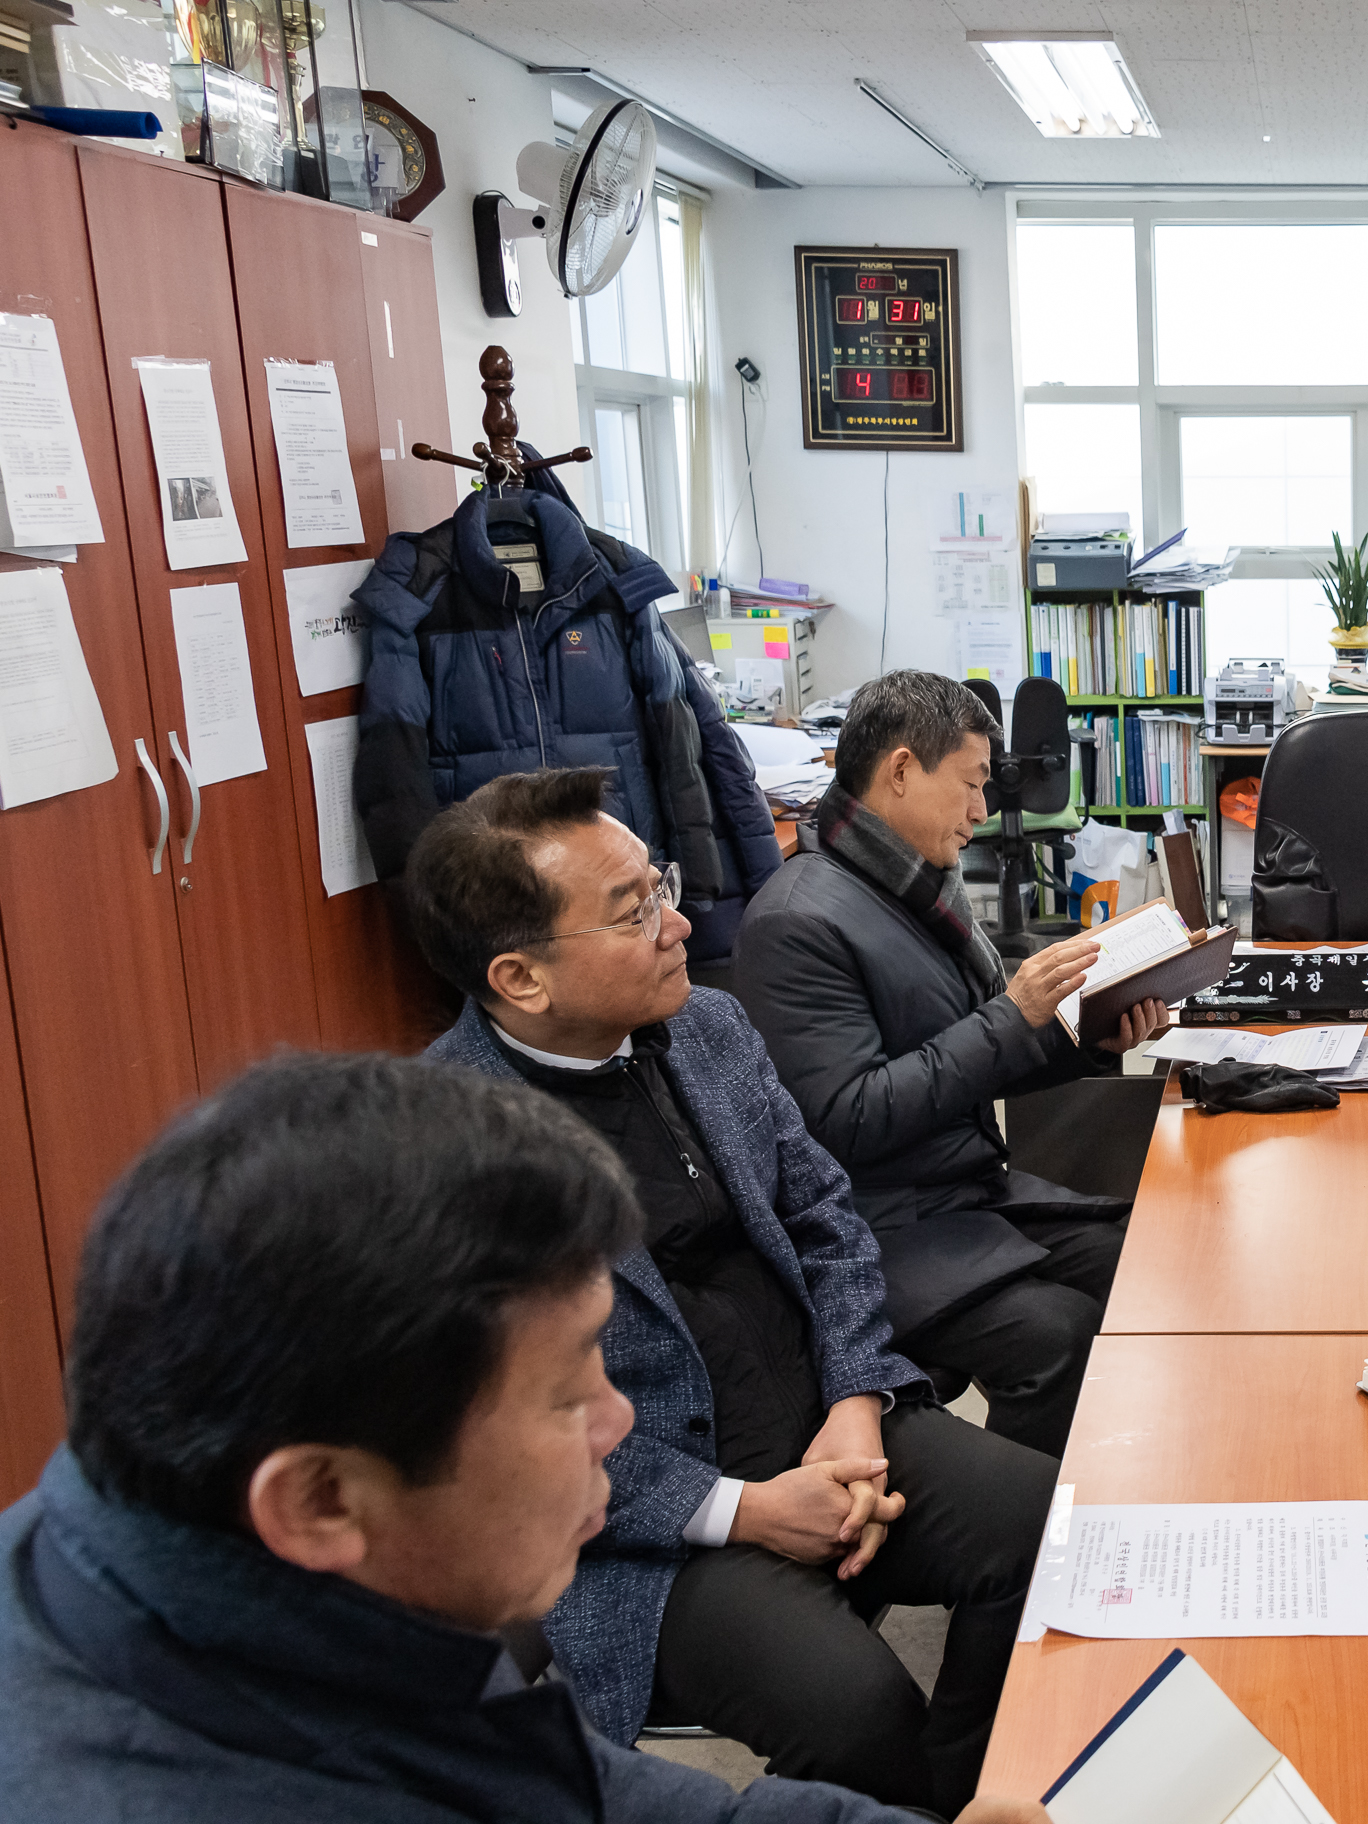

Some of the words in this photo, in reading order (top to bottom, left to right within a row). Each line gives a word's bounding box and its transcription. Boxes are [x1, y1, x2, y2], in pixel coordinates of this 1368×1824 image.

[860, 262, 893, 270] PHAROS
[859, 277, 876, 289] 20
[867, 300, 879, 321] 월
[891, 300, 920, 321] 31
[923, 301, 936, 320] 일
[856, 372, 871, 397] 4
[1258, 970, 1324, 993] 이사장
